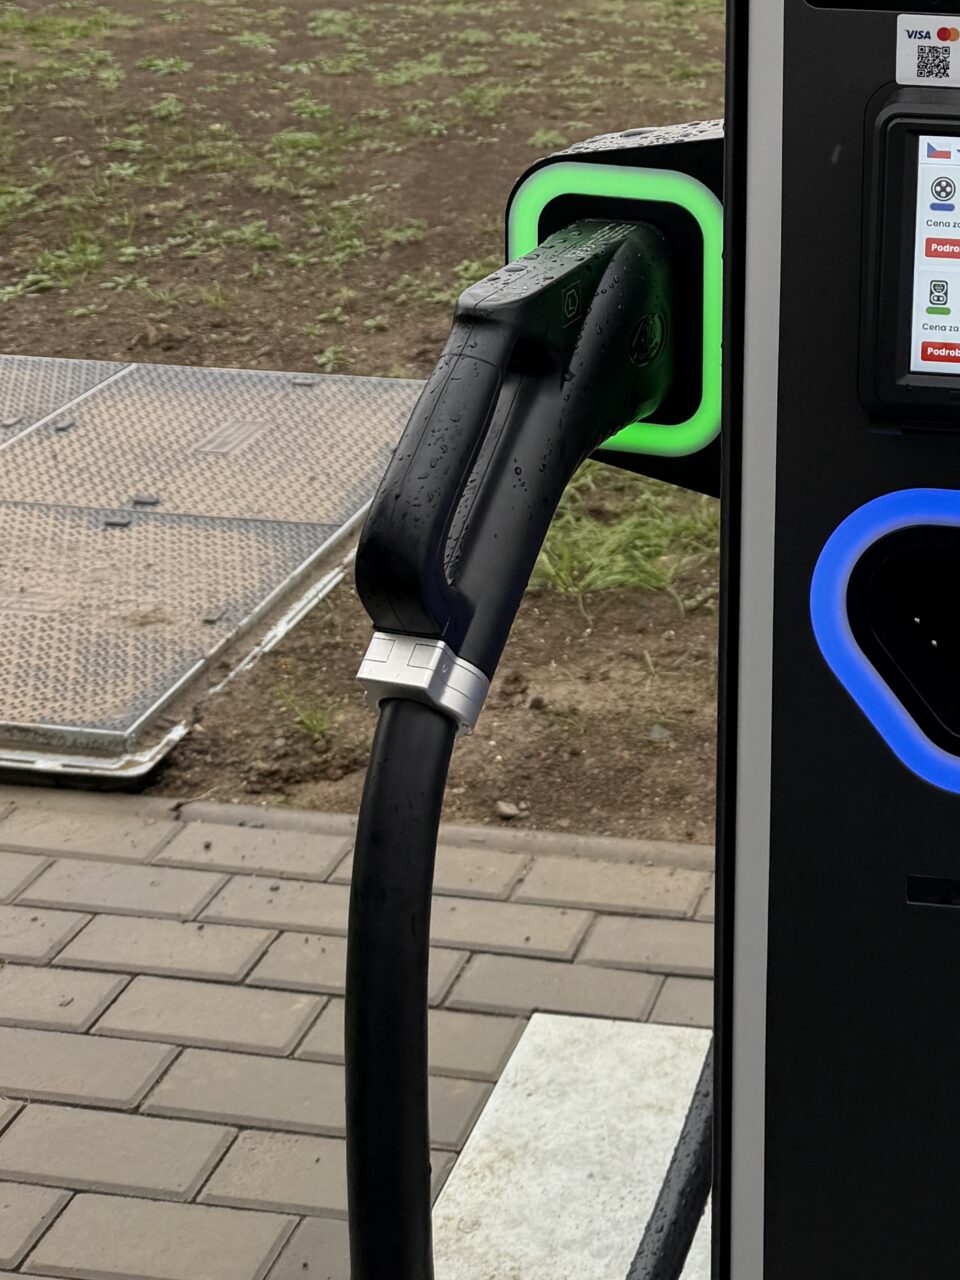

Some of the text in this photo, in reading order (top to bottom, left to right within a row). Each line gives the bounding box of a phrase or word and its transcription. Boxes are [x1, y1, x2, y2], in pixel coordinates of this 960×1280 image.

[905, 29, 931, 41] VISA
[926, 219, 951, 228] Cena
[922, 323, 946, 332] Cena
[948, 324, 959, 332] za
